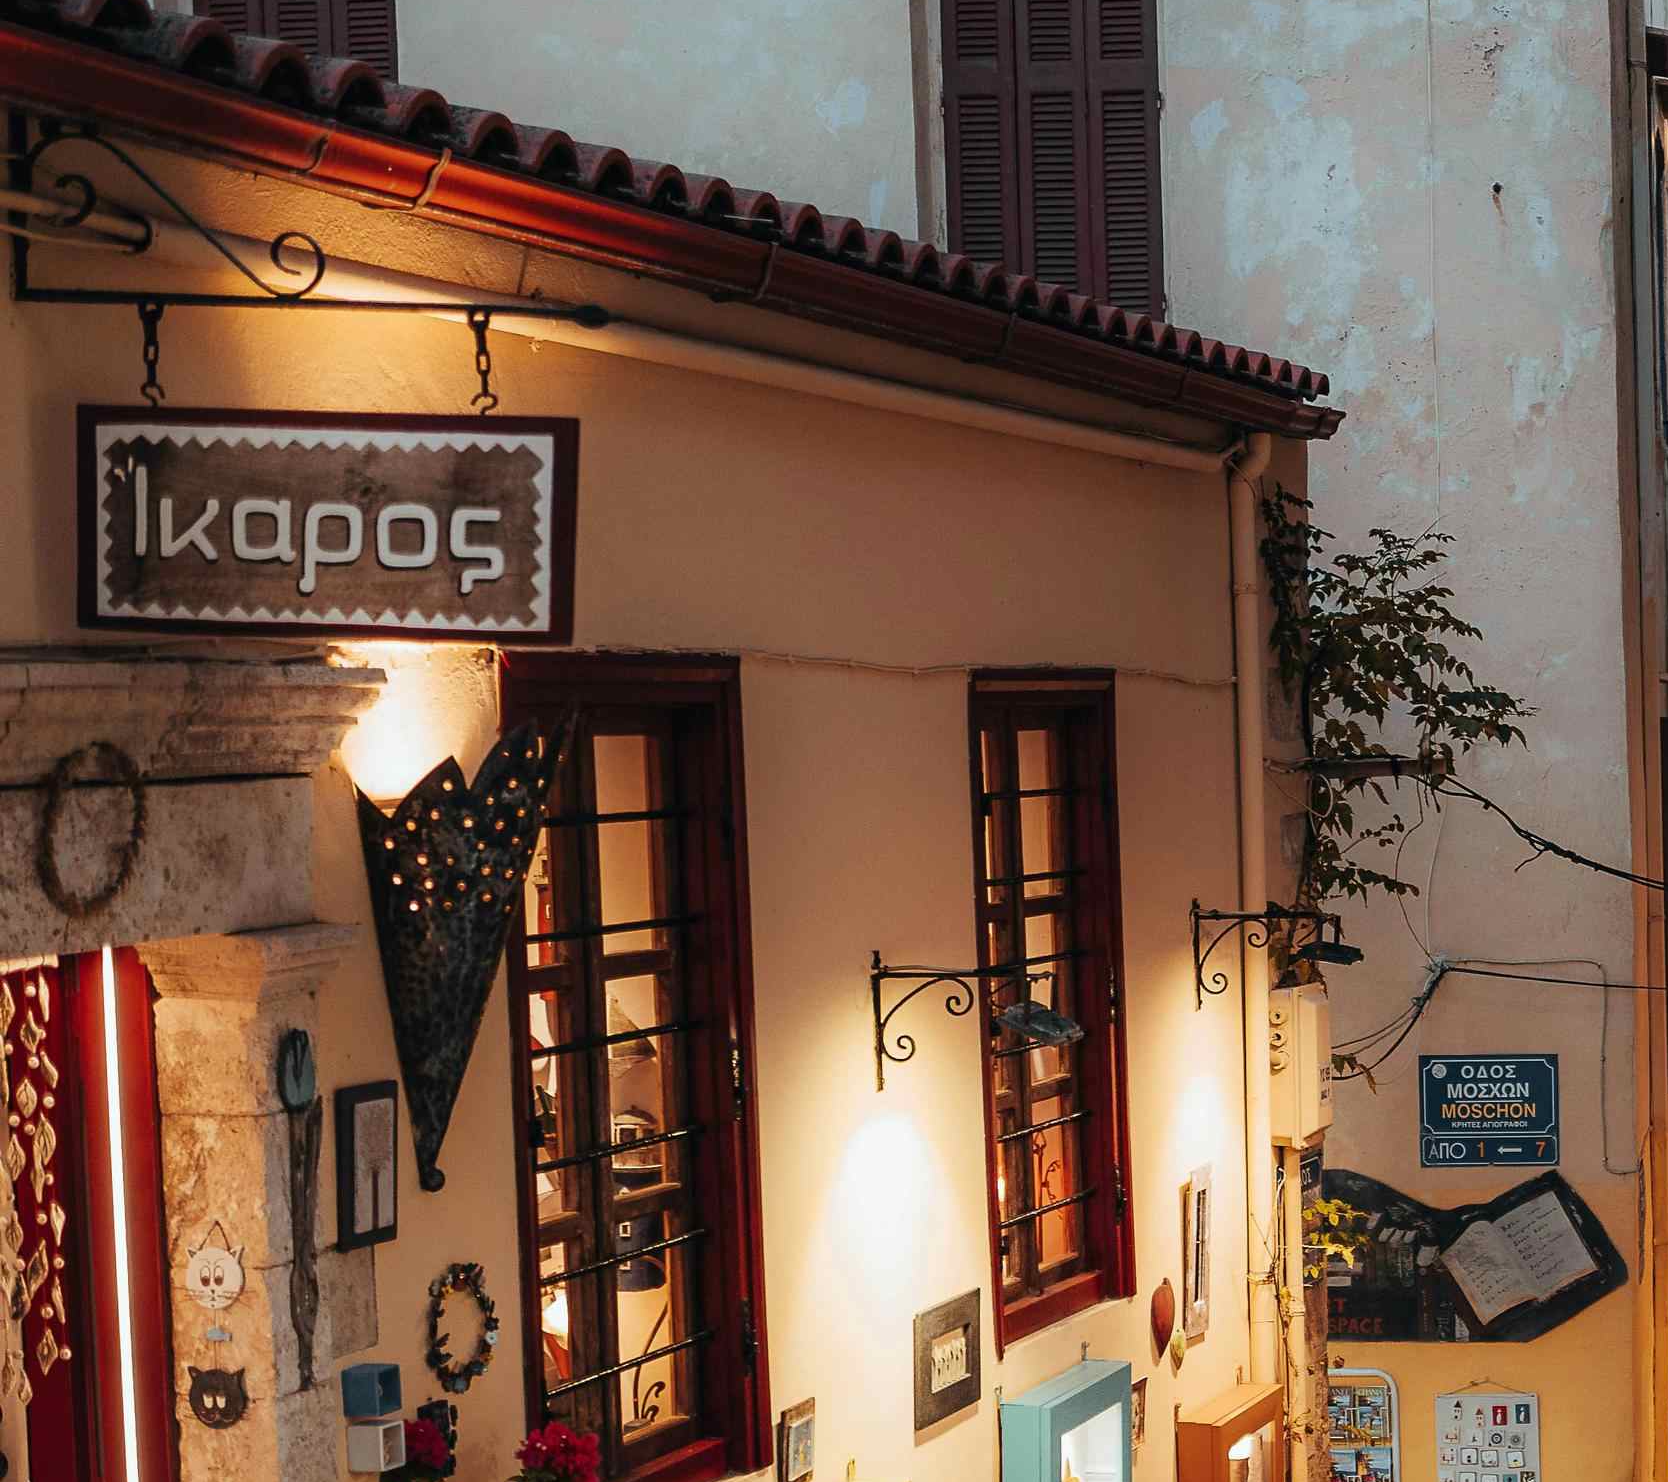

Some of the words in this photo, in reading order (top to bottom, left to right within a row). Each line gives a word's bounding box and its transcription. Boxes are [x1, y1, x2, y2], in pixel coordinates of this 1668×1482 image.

[1460, 1064, 1517, 1079] ΟΔΟΣ
[1446, 1082, 1530, 1099] ΜΟΣΧΩΝ
[1441, 1102, 1537, 1119] MOSCHON
[1476, 1140, 1486, 1158] 1
[1535, 1140, 1546, 1158] 7
[1328, 1316, 1384, 1334] SPACE
